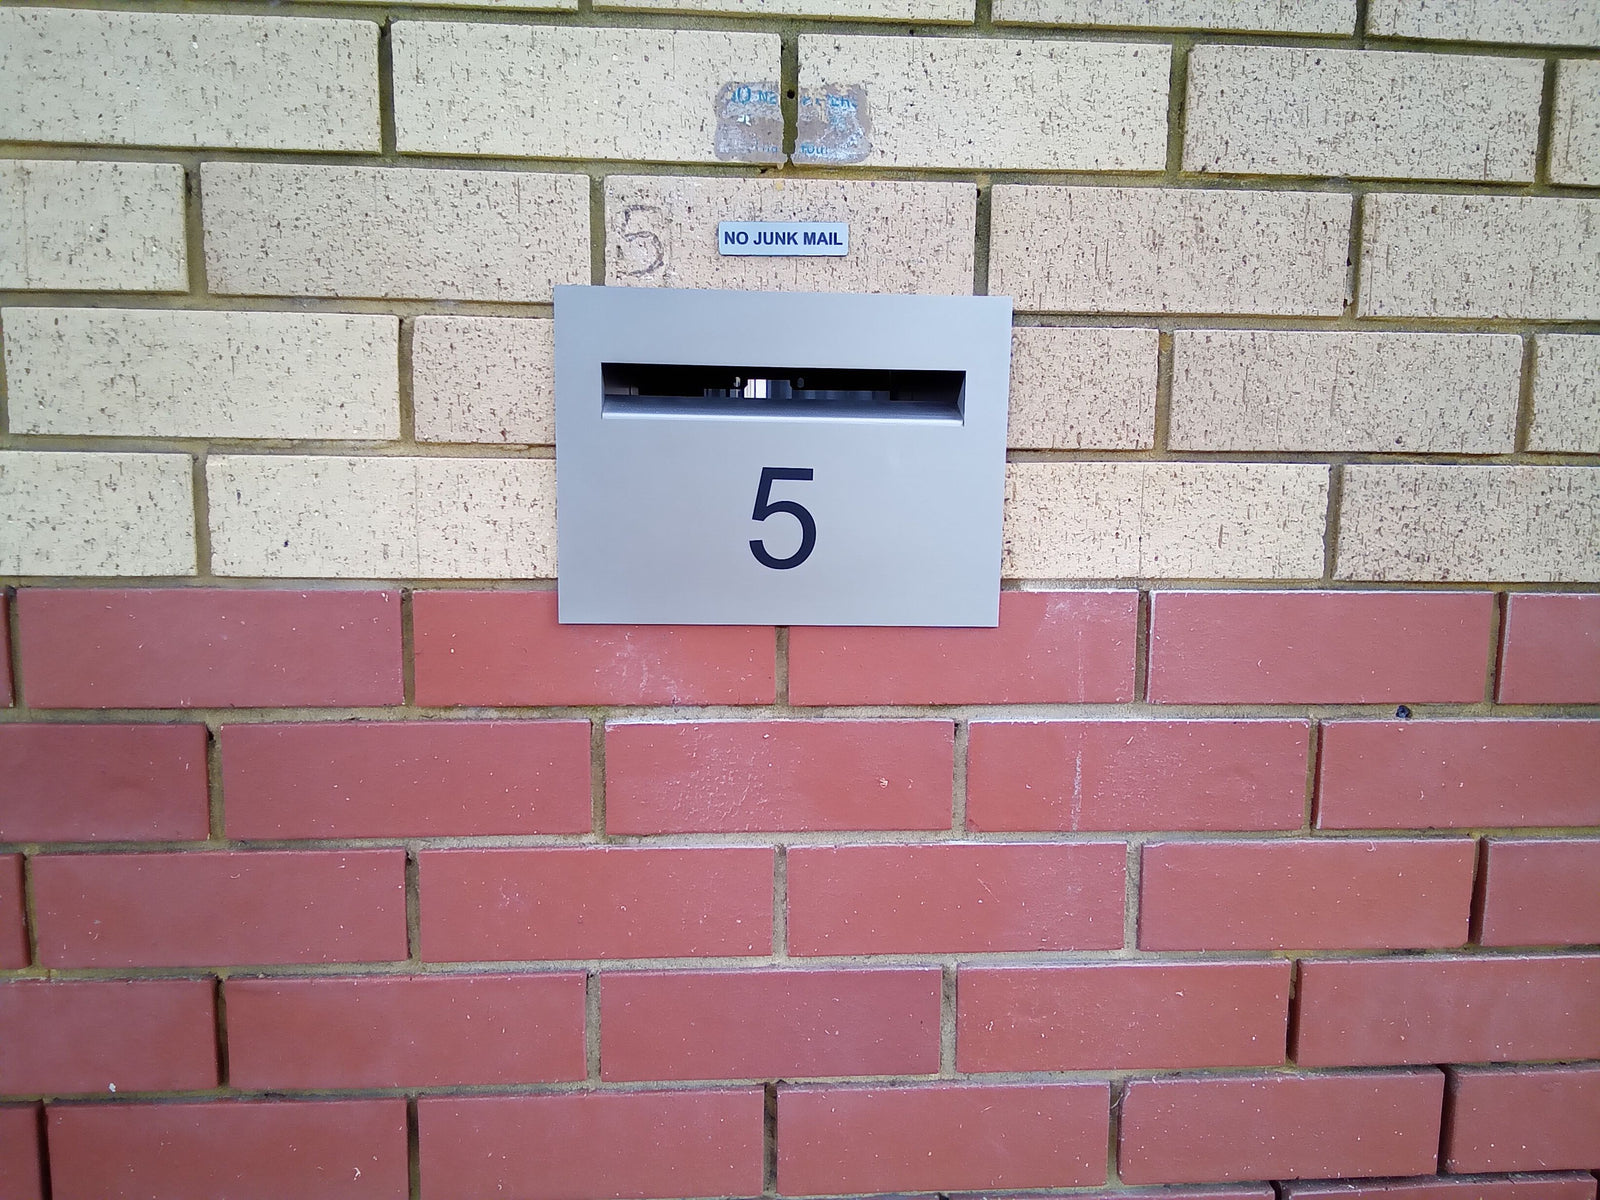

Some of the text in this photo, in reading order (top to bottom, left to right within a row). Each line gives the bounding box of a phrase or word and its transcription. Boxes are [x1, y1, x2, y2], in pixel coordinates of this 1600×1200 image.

[616, 203, 667, 279] 5
[724, 231, 844, 246] NO JUNK MAIL
[749, 467, 817, 570] 5
